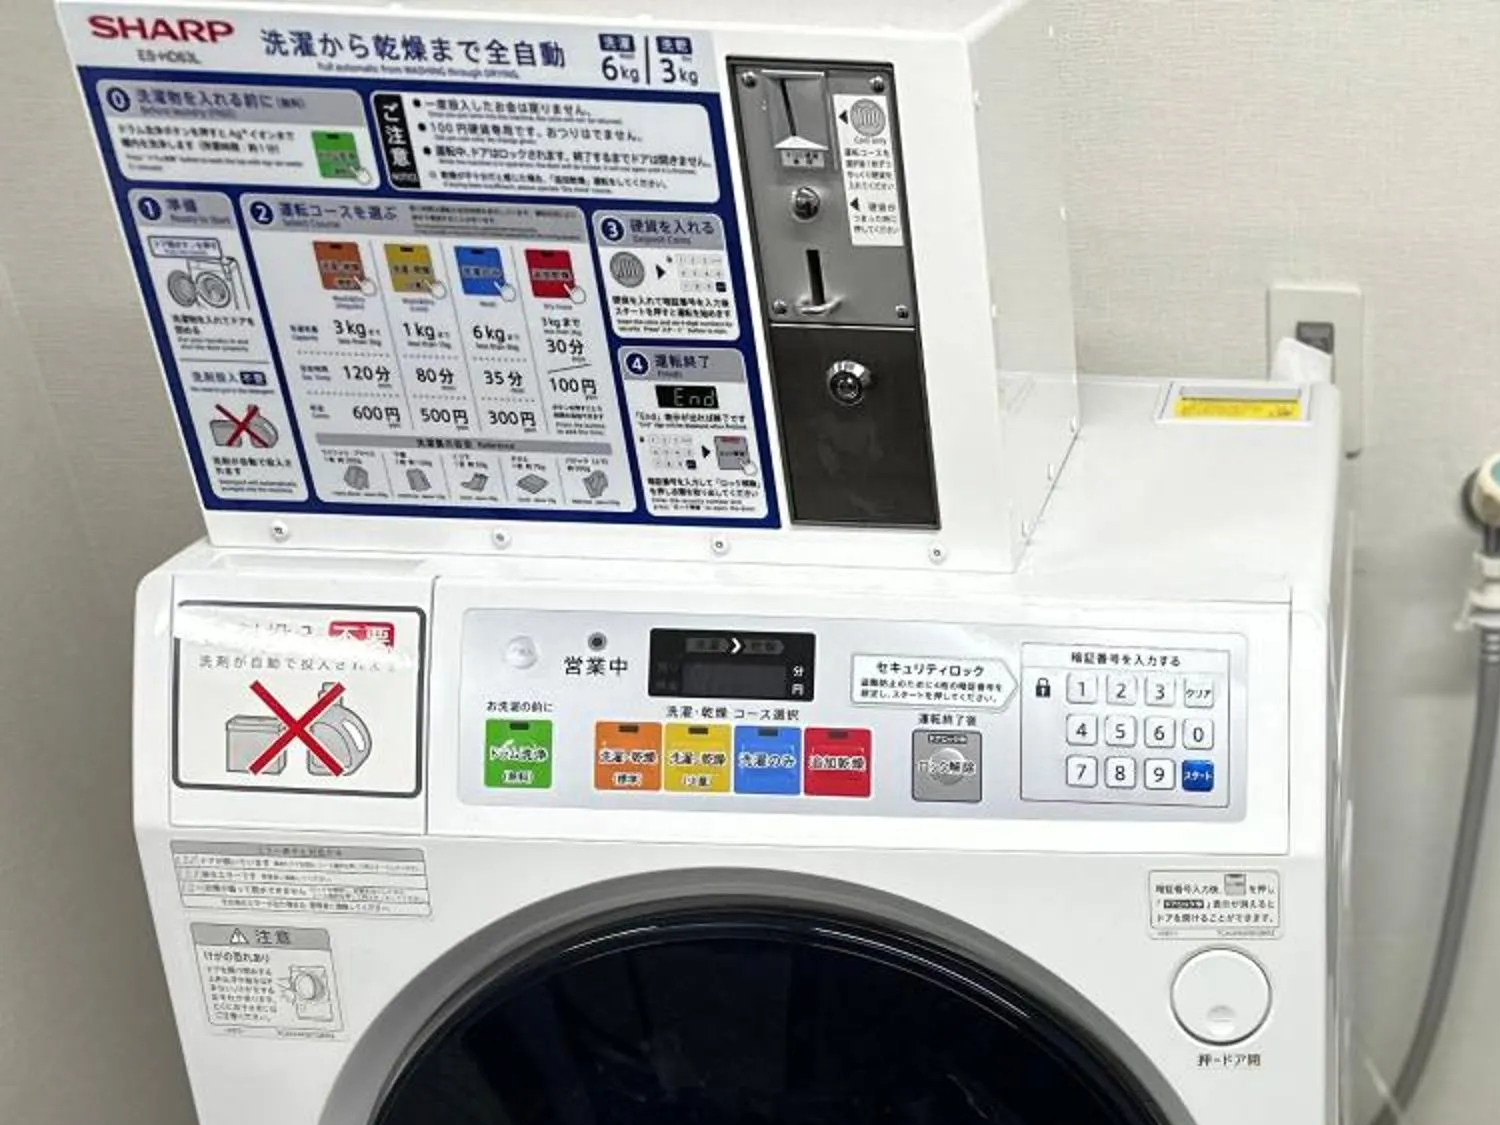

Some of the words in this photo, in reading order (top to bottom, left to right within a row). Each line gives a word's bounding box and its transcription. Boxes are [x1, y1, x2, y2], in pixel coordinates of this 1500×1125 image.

[87, 14, 235, 45] SHARP
[260, 28, 566, 69] 洗濯から乾燥まで全自動
[602, 55, 640, 85] 6kg
[661, 57, 699, 86] 3kg
[335, 319, 367, 339] 3kg
[473, 325, 505, 343] 6kg
[546, 338, 584, 355] 30分
[343, 365, 391, 382] 120分
[415, 367, 455, 384] 80分
[484, 370, 523, 387] 35分
[549, 377, 597, 395] 100円
[352, 405, 401, 423] 600円
[420, 407, 469, 425] 500円
[489, 410, 537, 427] 300円
[563, 655, 630, 677] 営業中
[1070, 651, 1182, 668] 暗証番号を入力する
[876, 661, 986, 678] セキュリティロック
[1185, 687, 1213, 700] クリア
[486, 700, 554, 714] お洗濯の前に
[733, 706, 800, 721] コース選択
[1076, 722, 1088, 738] 4
[1076, 764, 1087, 780] 7
